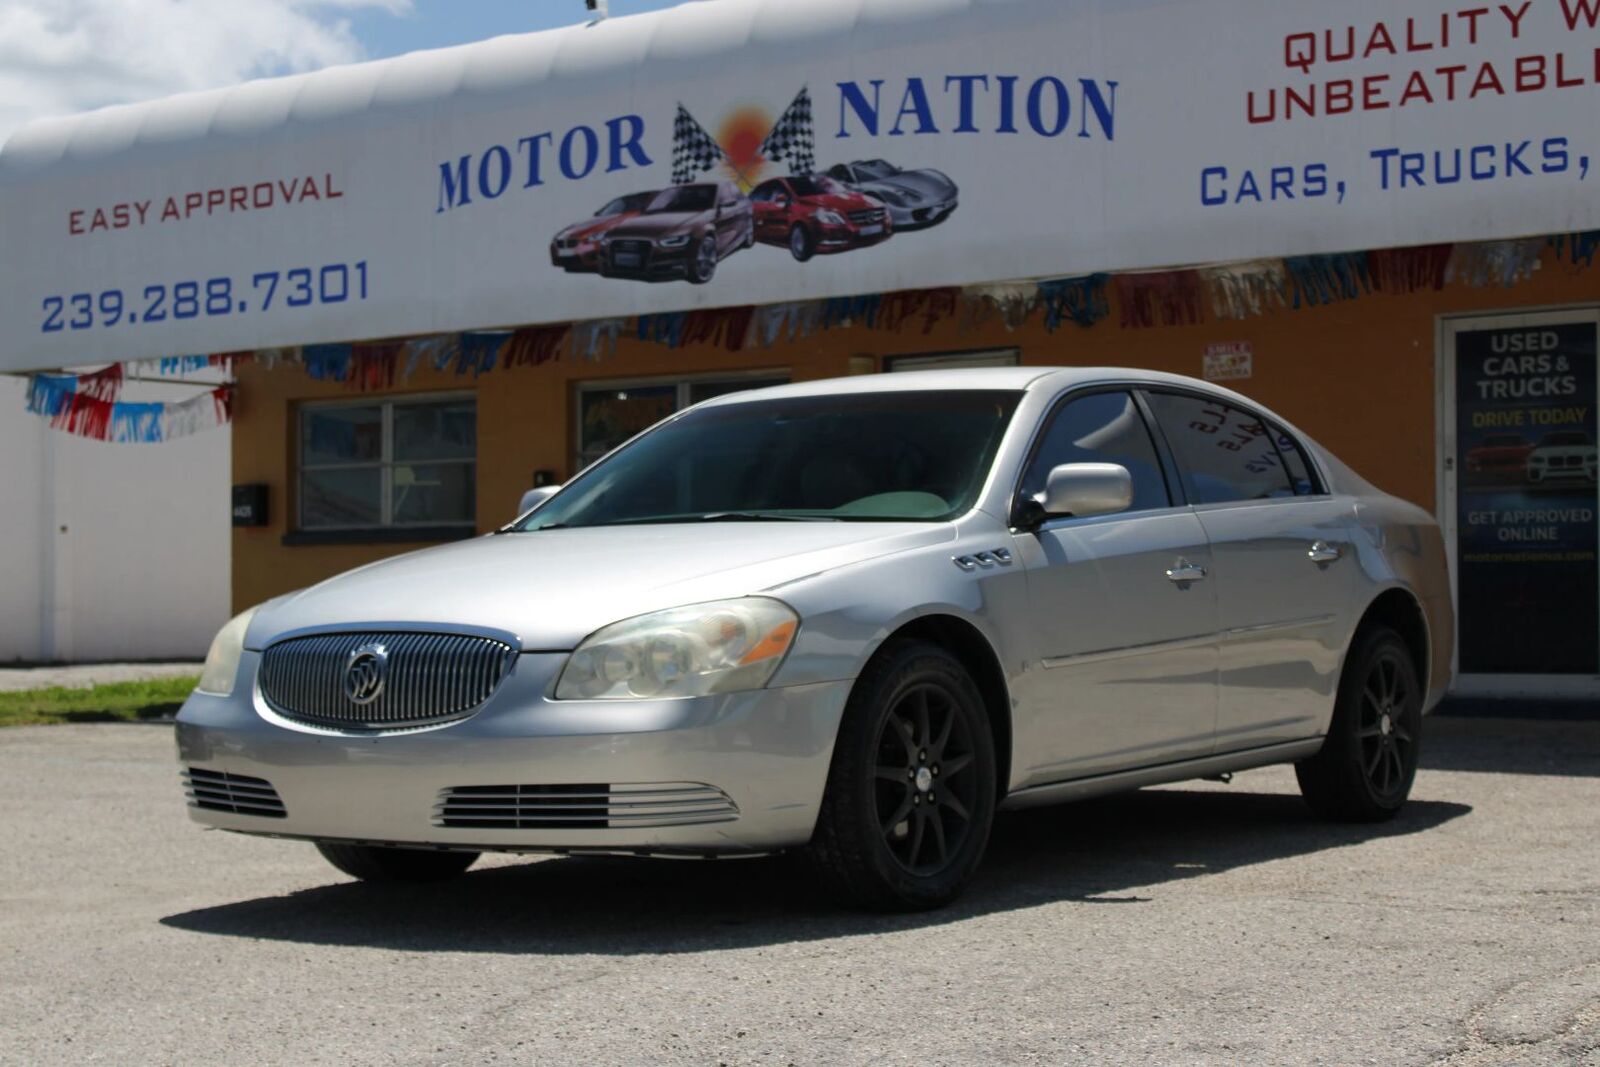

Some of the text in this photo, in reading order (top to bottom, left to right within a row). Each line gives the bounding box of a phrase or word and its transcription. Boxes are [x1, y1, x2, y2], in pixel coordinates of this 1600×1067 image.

[1285, 1, 1532, 74] QUALITY
[1247, 48, 1600, 124] UNBEATABL
[436, 75, 1119, 213] MOTOR NATION
[69, 174, 343, 235] EASY APPROVAL
[41, 261, 369, 332] 239.288.7301
[1491, 332, 1559, 352] USED
[1483, 354, 1570, 376] CARS &
[1477, 376, 1577, 398] TRUCKS
[1473, 408, 1587, 427] DRIVE TODAY
[1468, 508, 1593, 525] GET APPROVED
[1498, 527, 1559, 541] ONLINE
